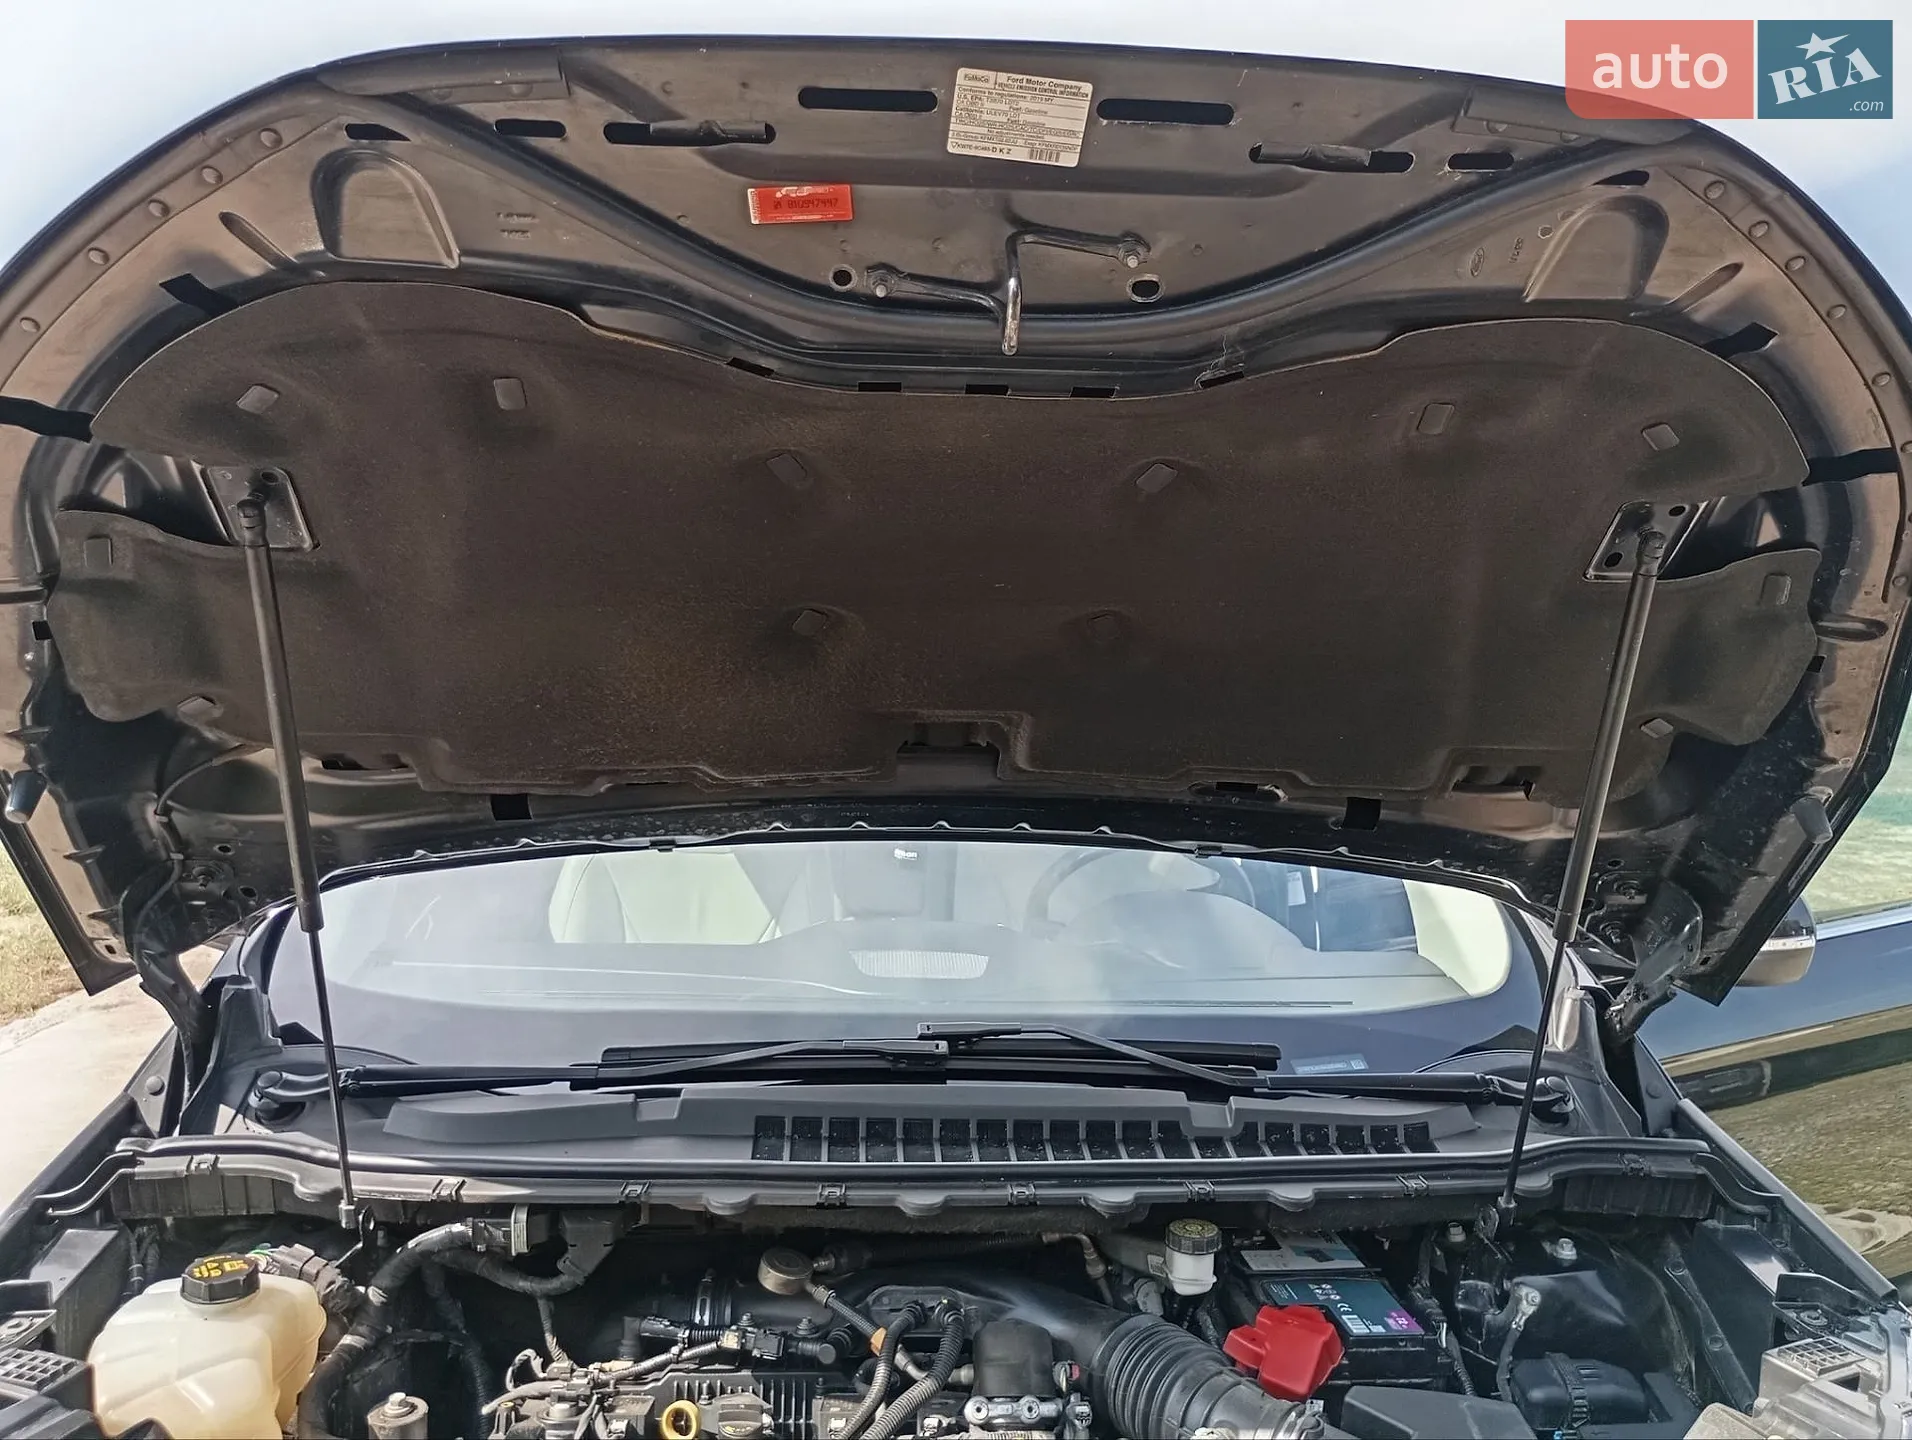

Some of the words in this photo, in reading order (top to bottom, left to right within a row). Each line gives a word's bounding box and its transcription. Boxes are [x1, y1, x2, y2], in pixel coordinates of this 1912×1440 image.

[1007, 75, 1023, 84] Ford
[1026, 77, 1046, 87] Motor
[1048, 80, 1082, 92] Company
[958, 86, 986, 95] Conforms
[1038, 87, 1058, 95] CONTROL
[1059, 88, 1089, 99] INFORMATION
